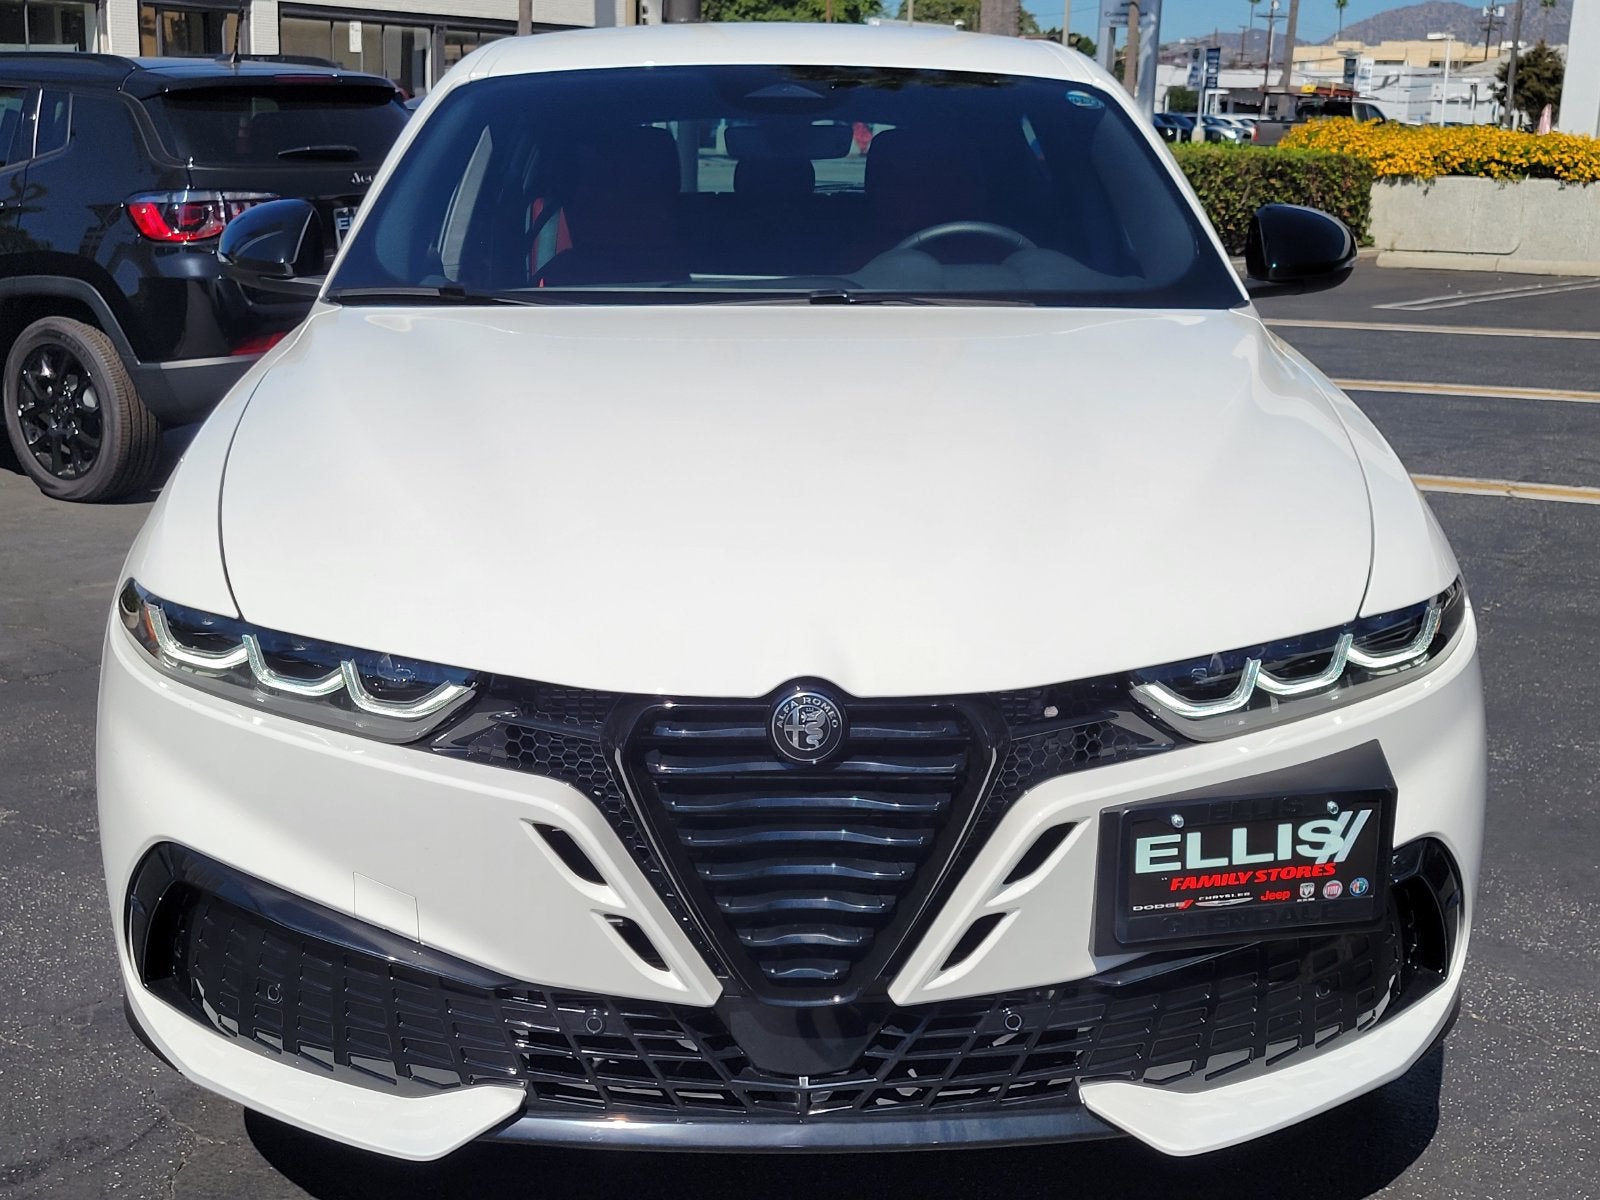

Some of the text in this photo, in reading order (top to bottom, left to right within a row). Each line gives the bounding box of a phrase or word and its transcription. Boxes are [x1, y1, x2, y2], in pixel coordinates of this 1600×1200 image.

[776, 697, 839, 729] ALFA ROMEO
[1135, 818, 1345, 874] ELLIS
[1169, 870, 1254, 891] FAMILY
[1253, 862, 1337, 883] STORES
[1198, 891, 1251, 901] CHRYSLER
[1260, 890, 1291, 901] Jeep
[1132, 901, 1185, 912] DODGE
